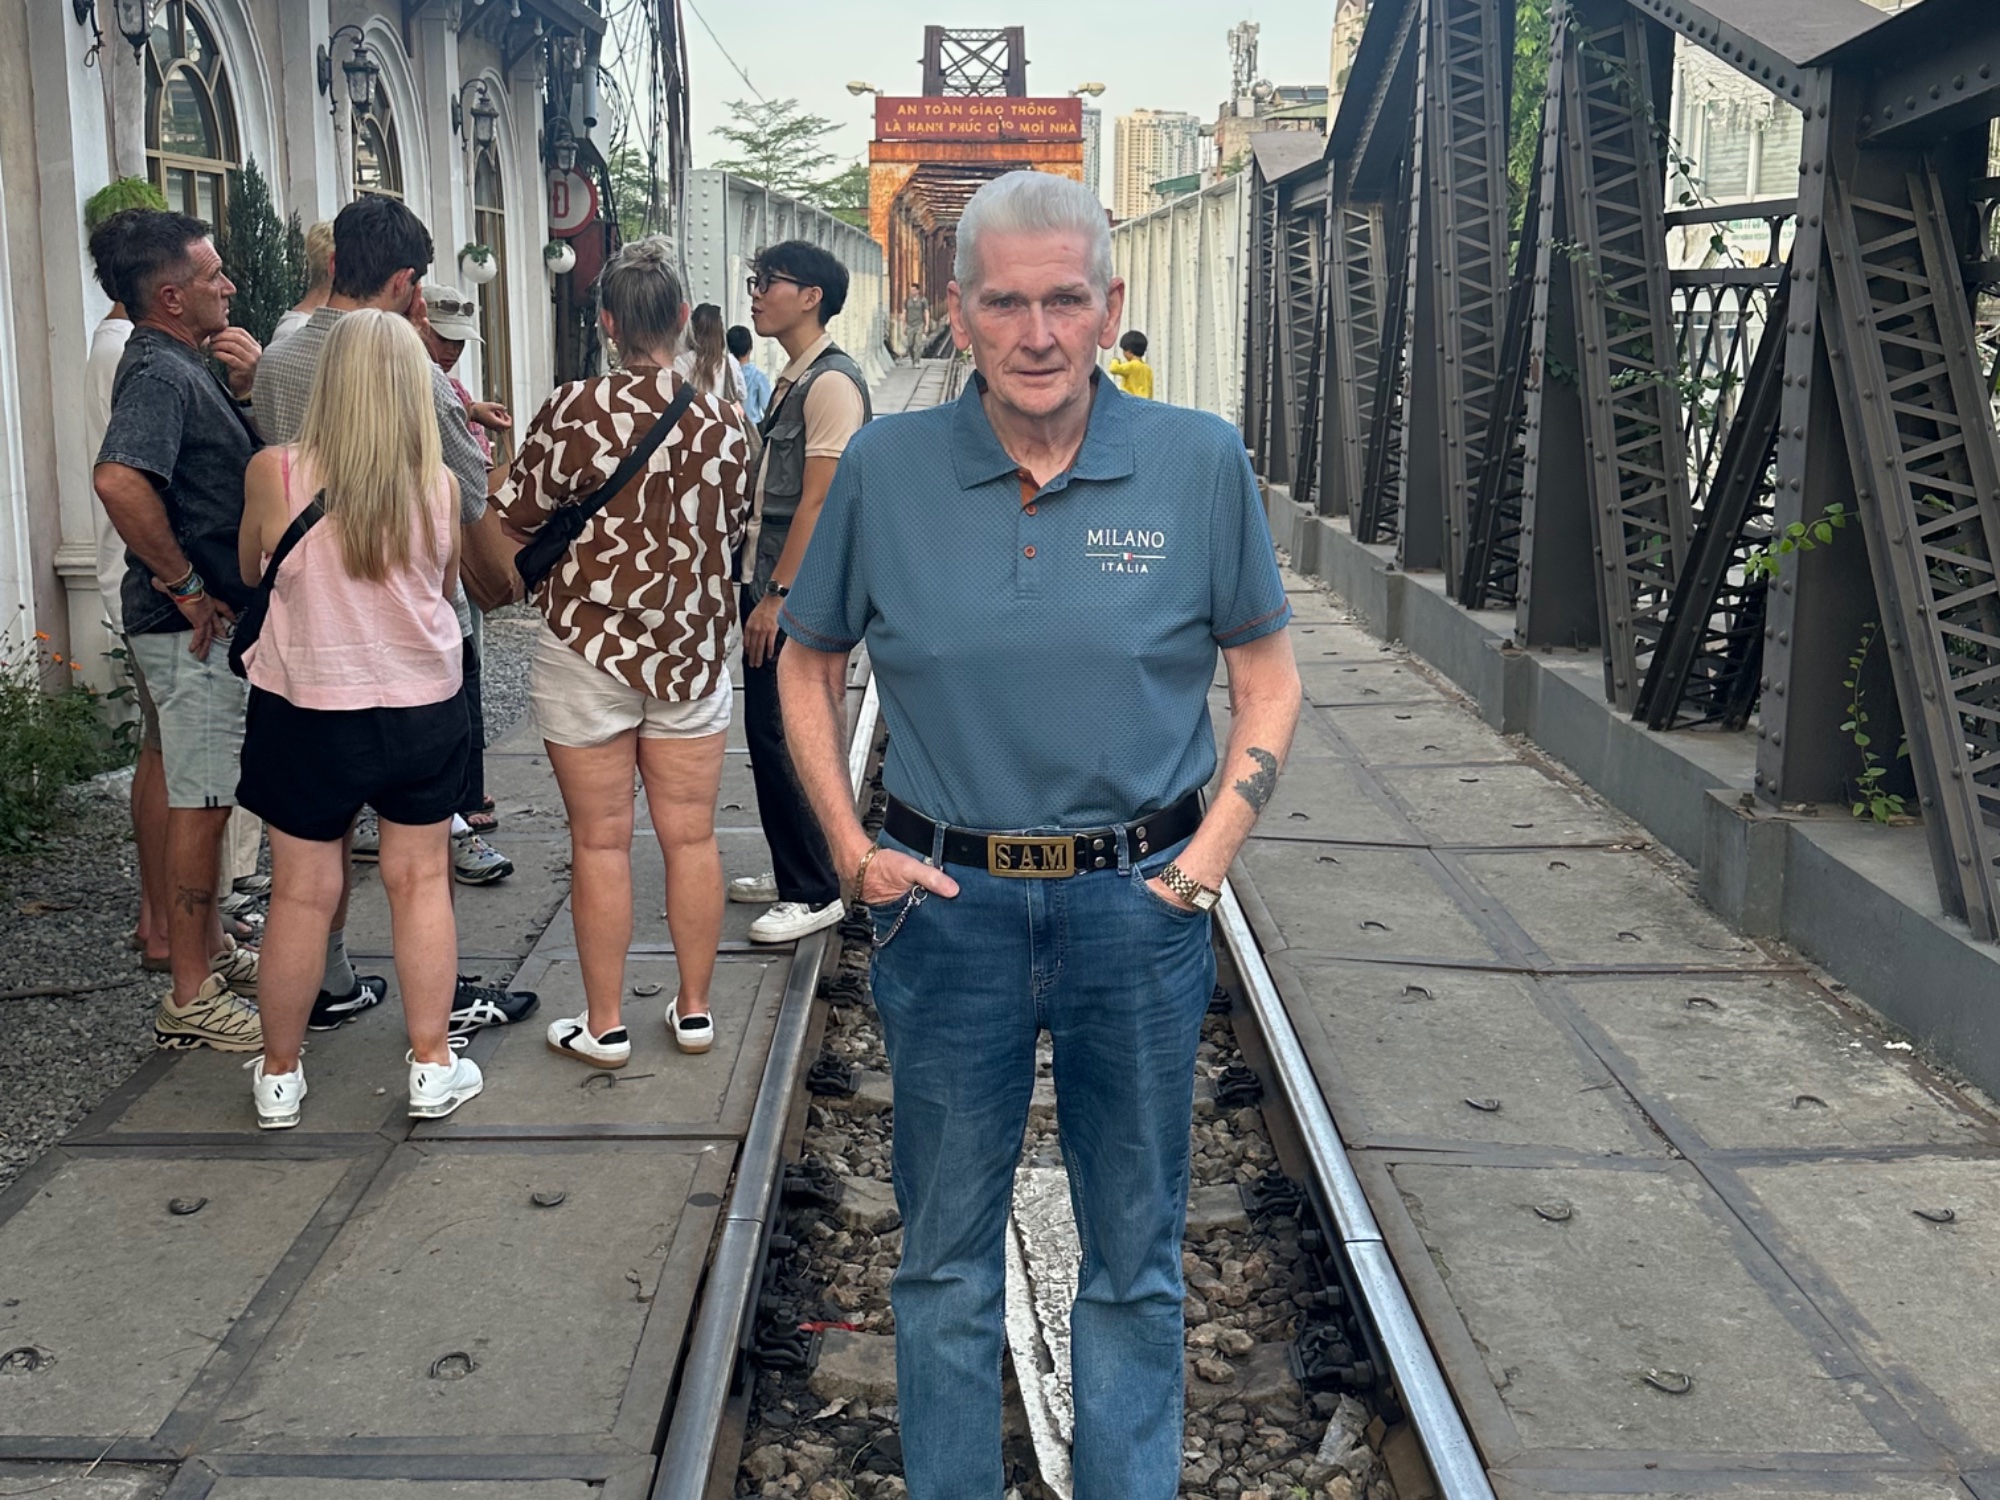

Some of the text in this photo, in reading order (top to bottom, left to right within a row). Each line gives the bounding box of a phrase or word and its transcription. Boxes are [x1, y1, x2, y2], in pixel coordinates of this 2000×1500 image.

[897, 104, 918, 115] AN
[924, 101, 963, 115] TOÀN
[1010, 101, 1057, 116] THÔNG
[884, 118, 902, 132] LÀ
[907, 122, 944, 135] HẠNH
[949, 118, 982, 132] PHÚC
[1049, 118, 1077, 133] NHÀ
[1086, 528, 1165, 548] MILANO
[1101, 562, 1149, 573] ITALIA
[995, 844, 1066, 870] SAM
